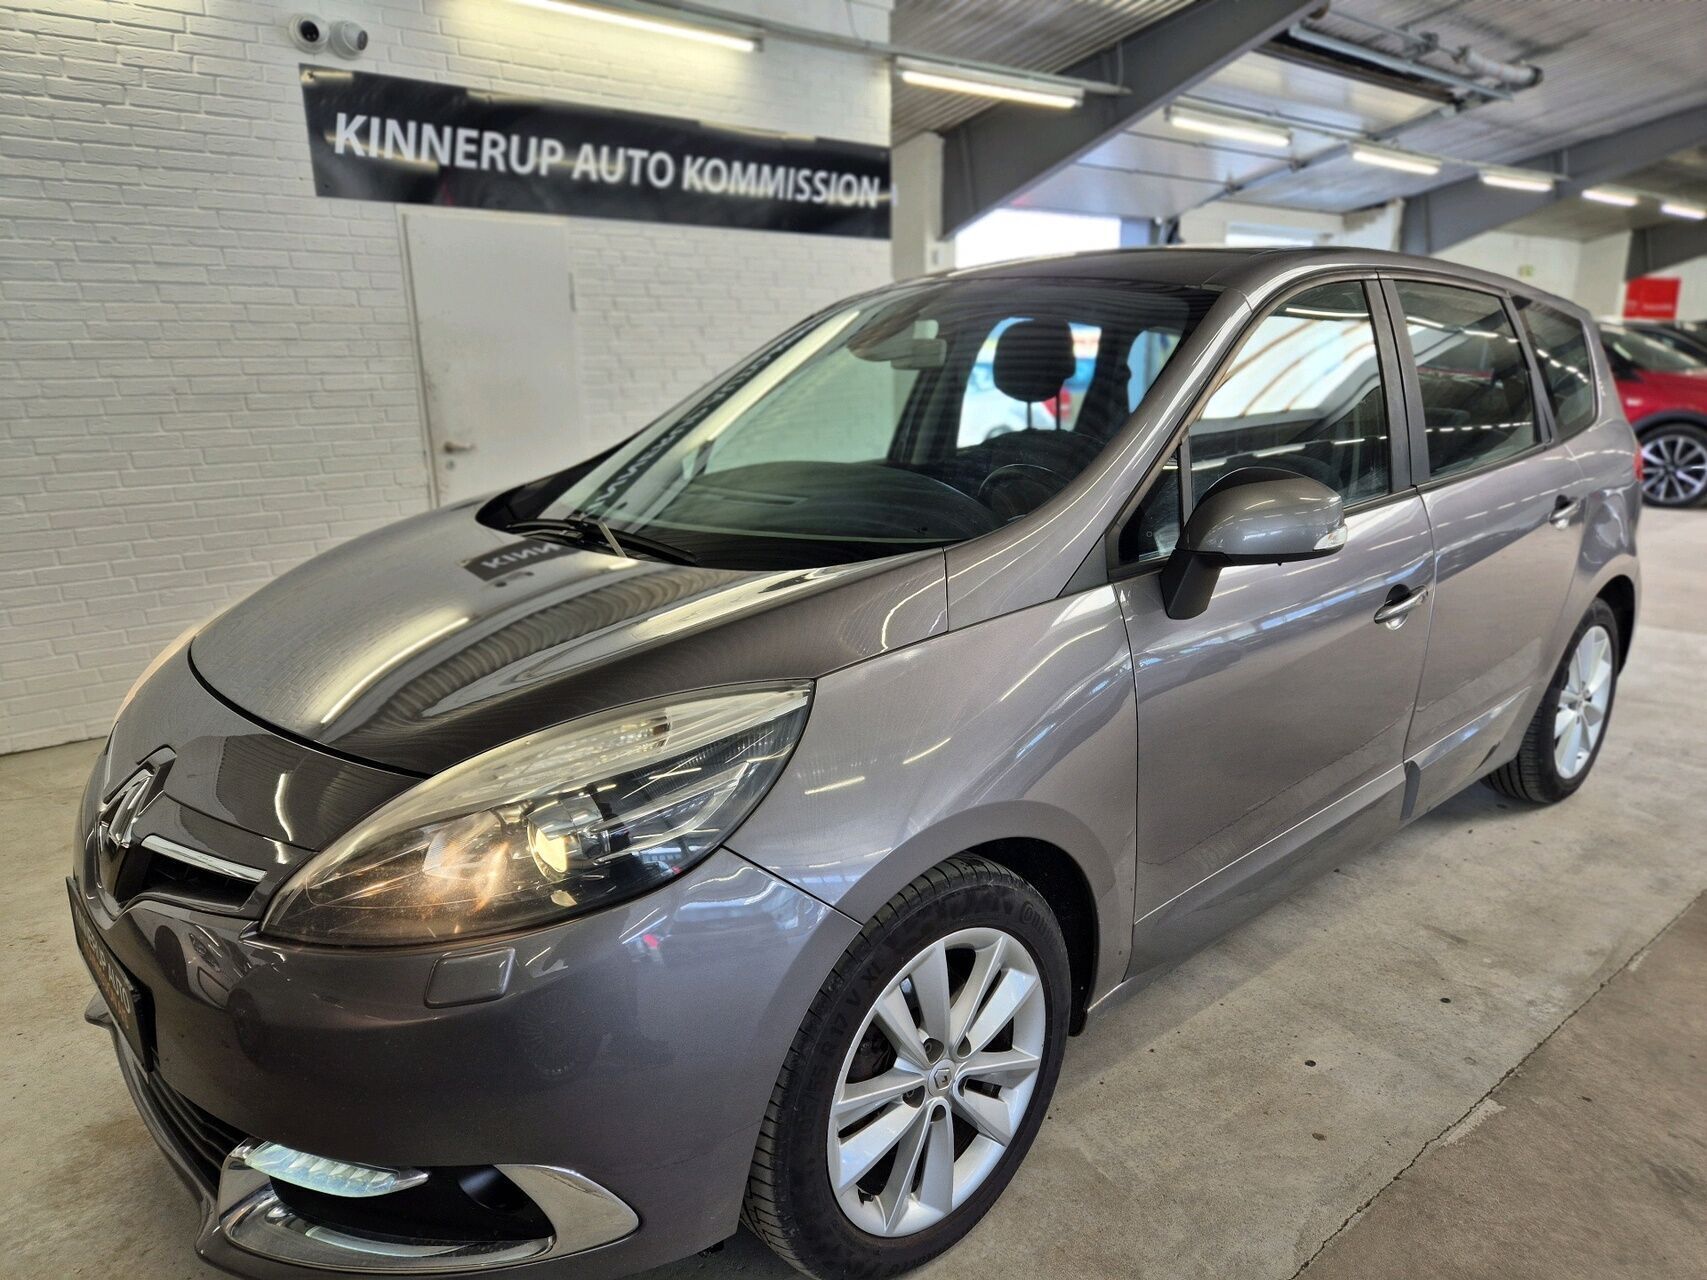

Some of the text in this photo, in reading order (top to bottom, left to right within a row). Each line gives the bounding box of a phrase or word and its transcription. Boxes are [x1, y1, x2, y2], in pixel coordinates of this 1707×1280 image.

[334, 112, 880, 209] KINNERUP AUTO KOMMISSION
